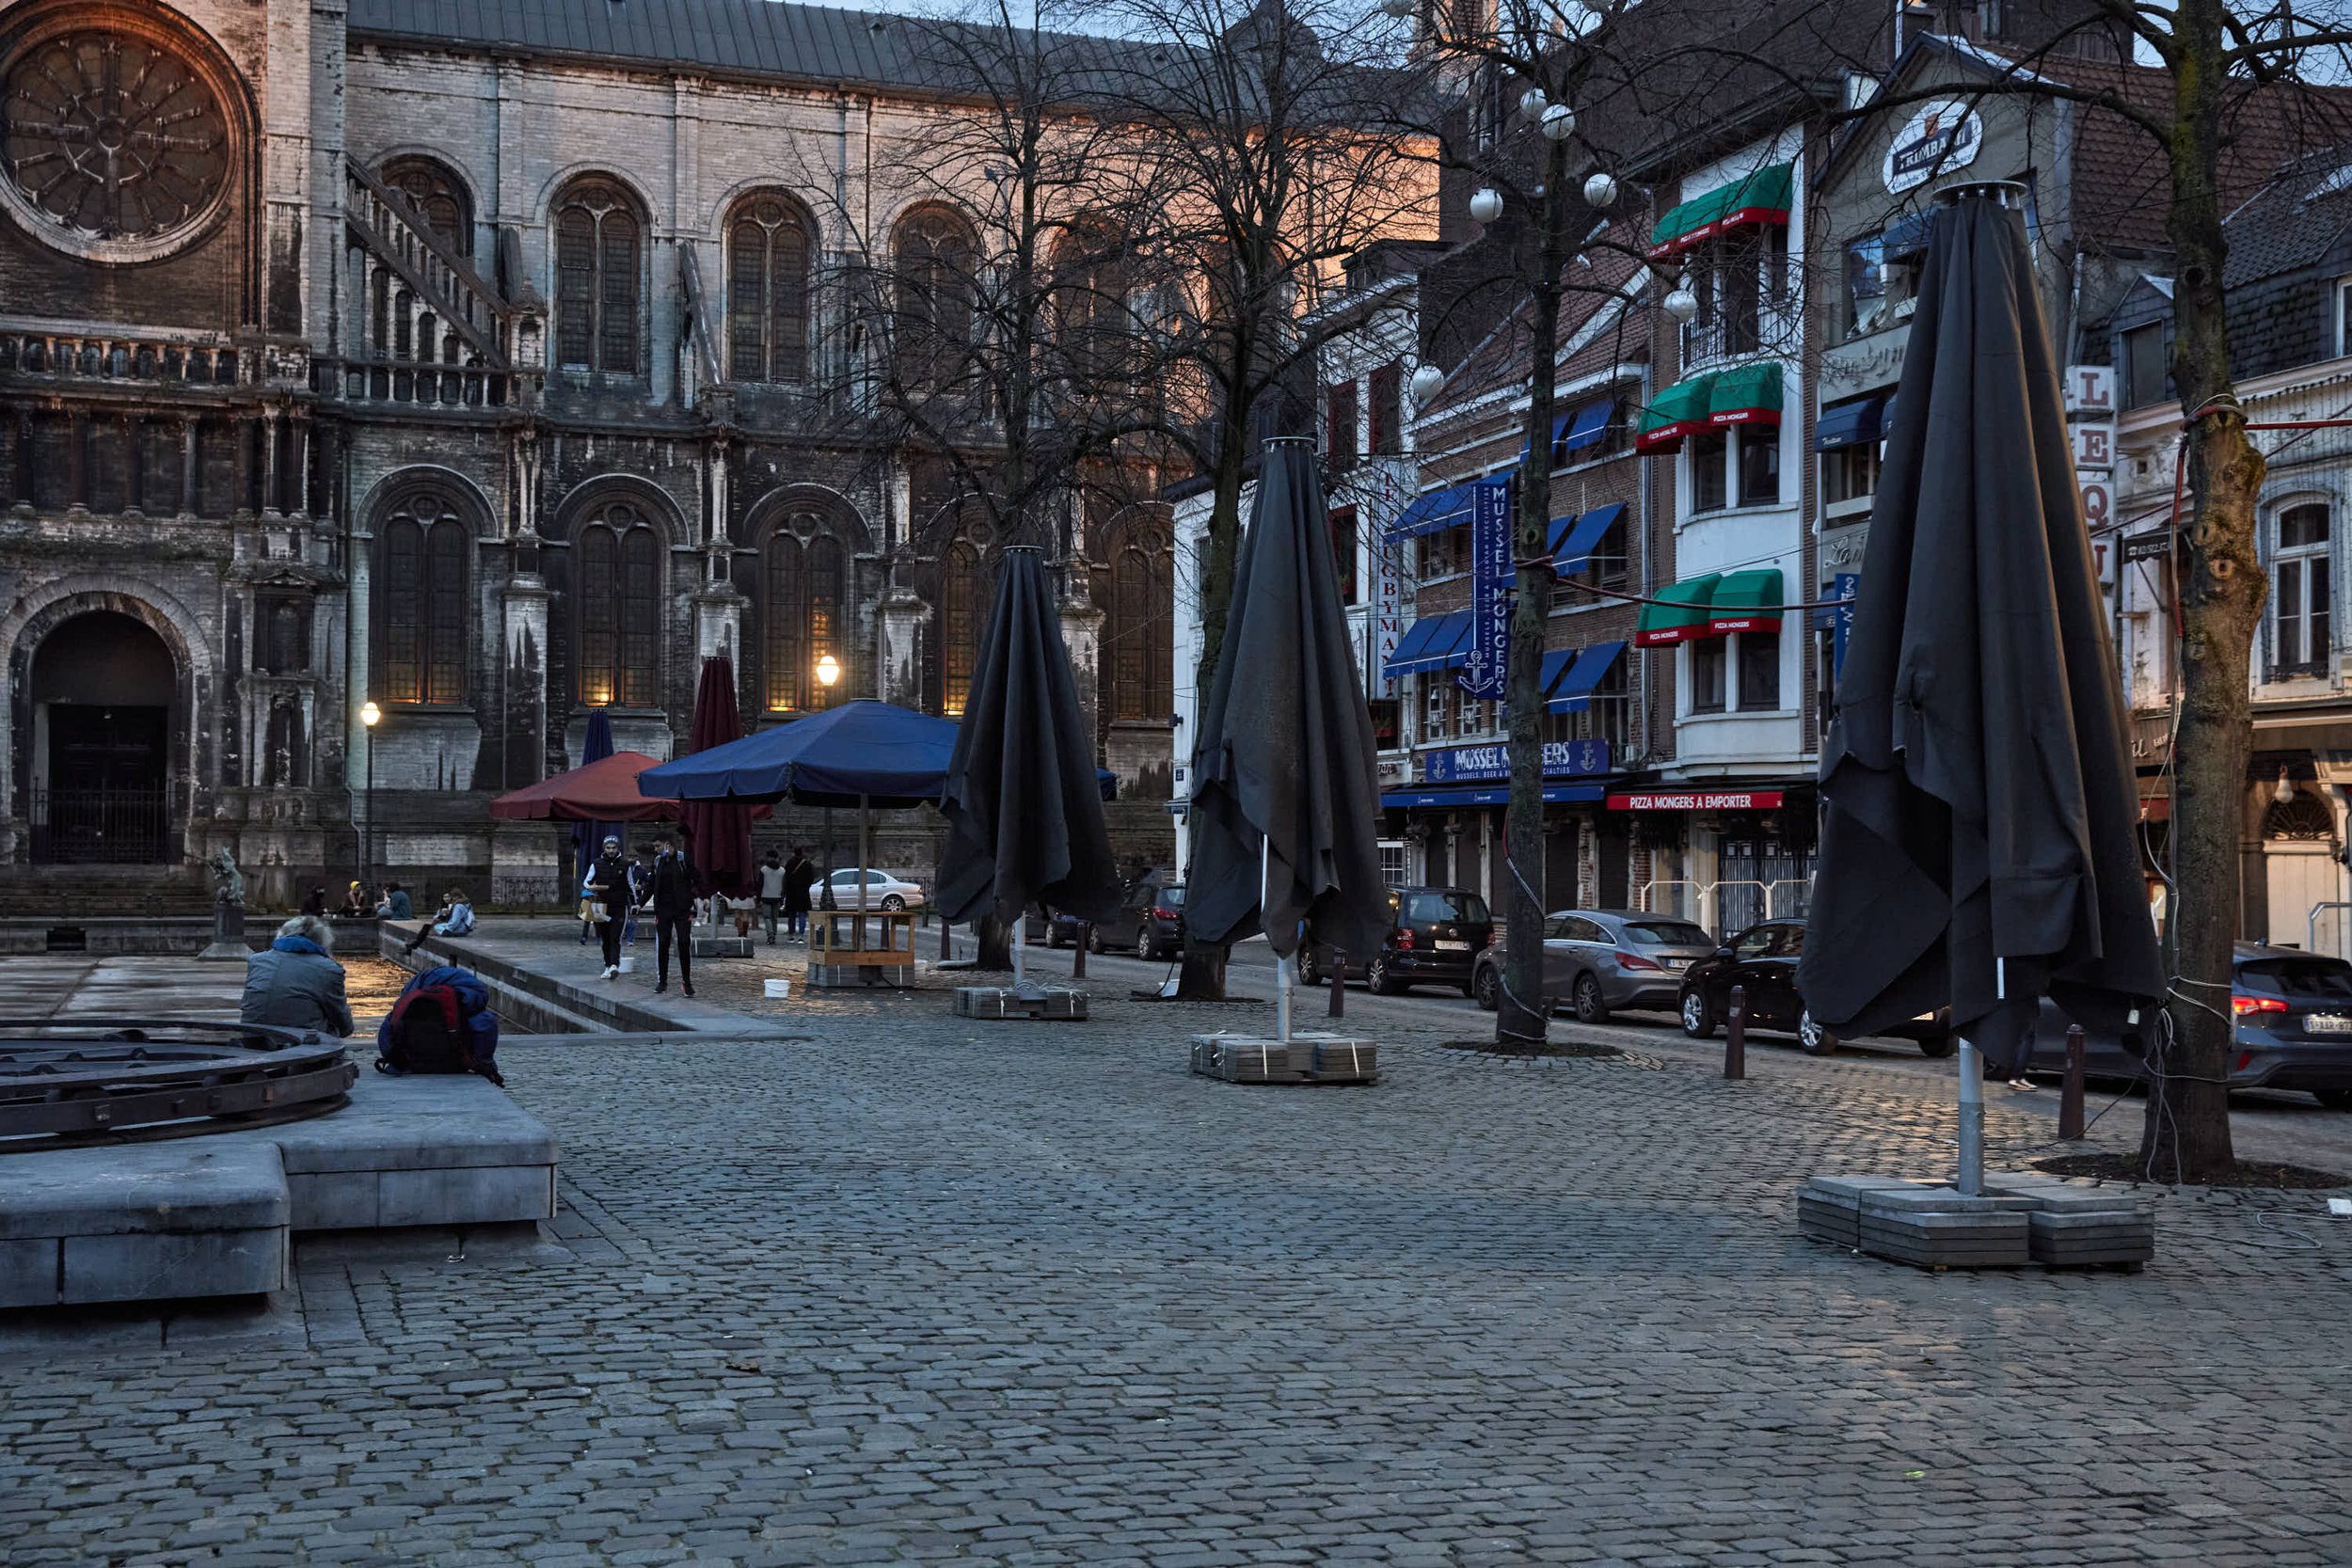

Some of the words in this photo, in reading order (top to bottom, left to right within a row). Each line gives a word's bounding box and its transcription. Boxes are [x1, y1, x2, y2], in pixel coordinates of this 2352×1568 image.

[1899, 130, 1967, 171] TRIMBAH
[1493, 486, 1506, 578] MUSSEL
[1380, 526, 1397, 669] UGBYMA
[1493, 587, 1506, 694] MONGERS
[1454, 747, 1501, 771] MUSSEL
[1629, 797, 1653, 810] PIZZA
[1654, 796, 1694, 809] MONGERS
[1696, 796, 1703, 809] A
[1705, 794, 1751, 809] EMPORTER
